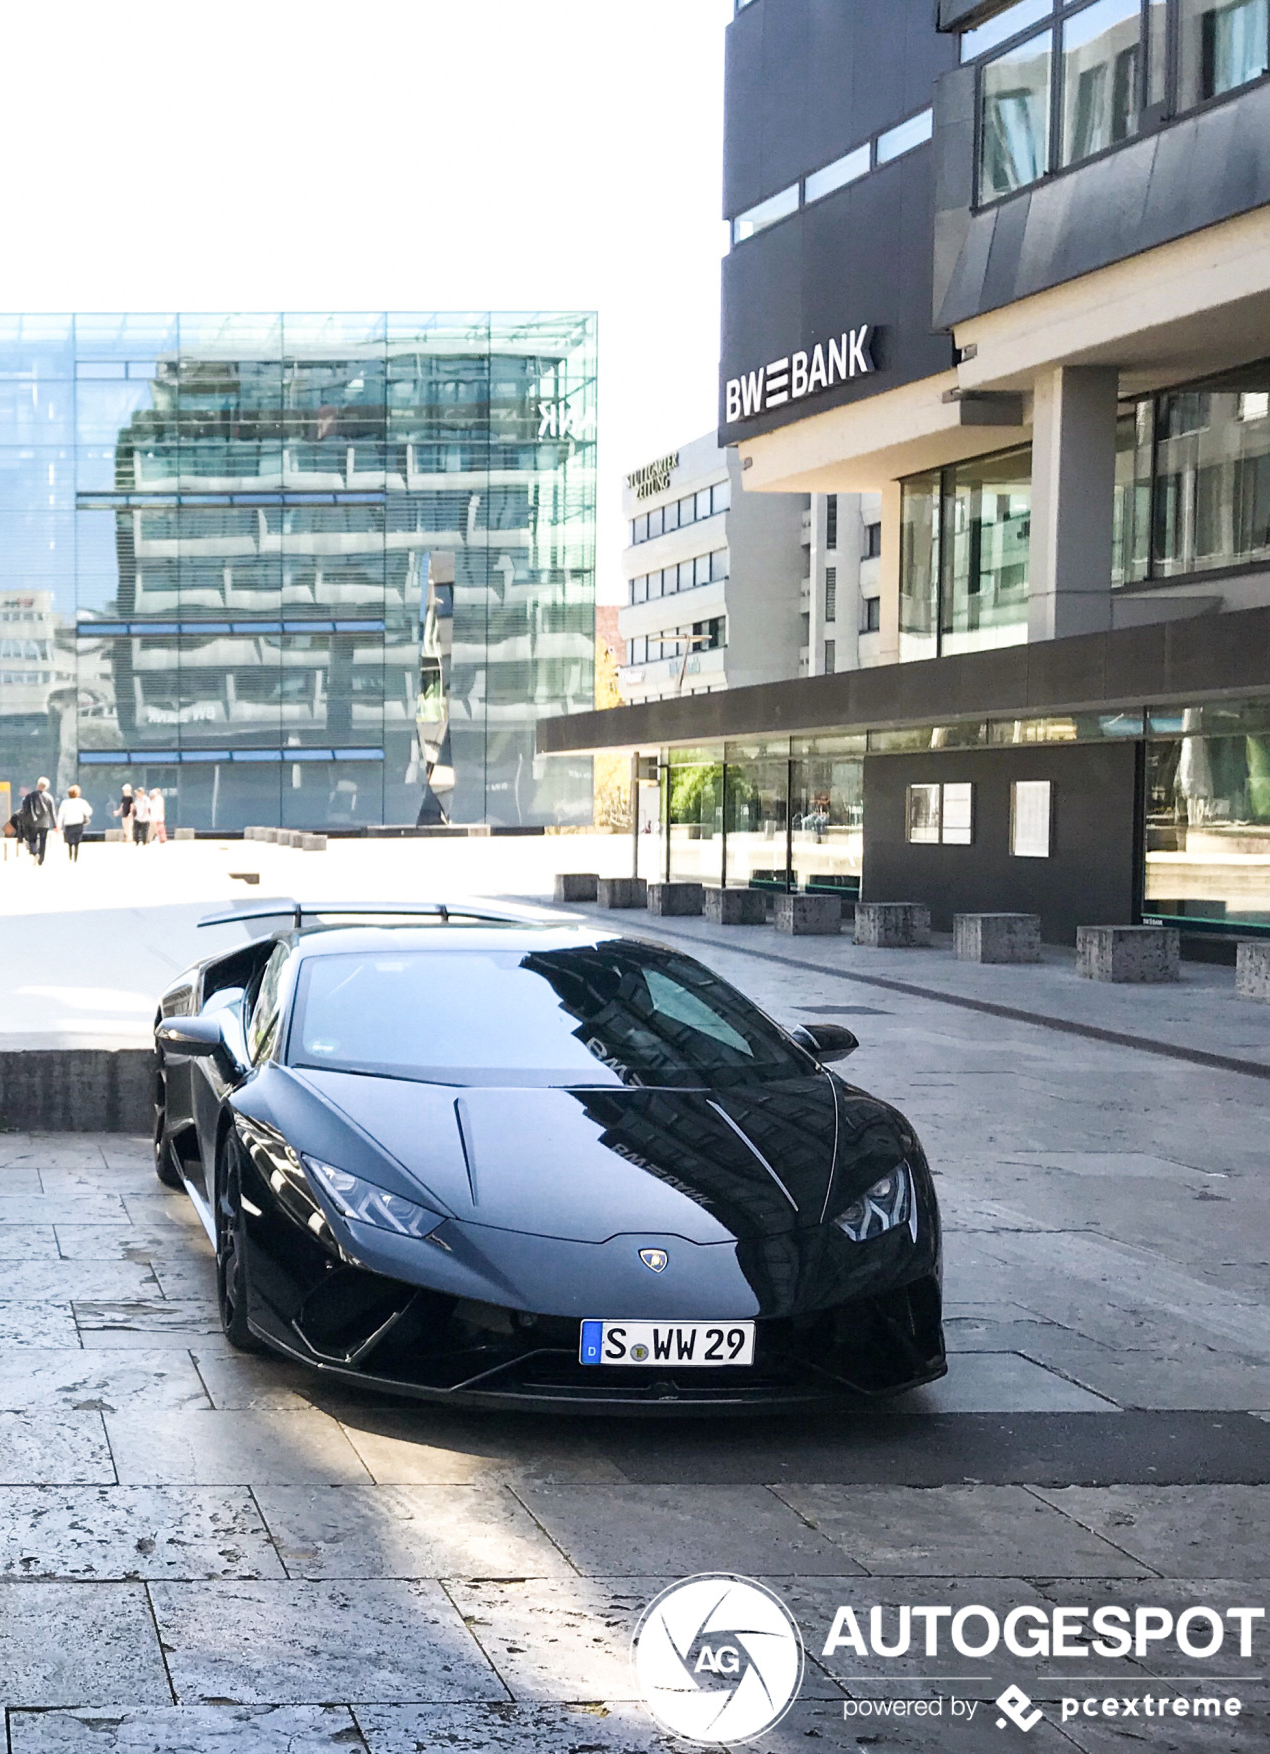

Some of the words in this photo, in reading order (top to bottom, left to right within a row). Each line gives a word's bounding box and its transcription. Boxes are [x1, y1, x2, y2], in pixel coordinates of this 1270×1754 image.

[605, 1328, 627, 1359] S
[653, 1328, 697, 1360] WW
[704, 1328, 745, 1360] 29
